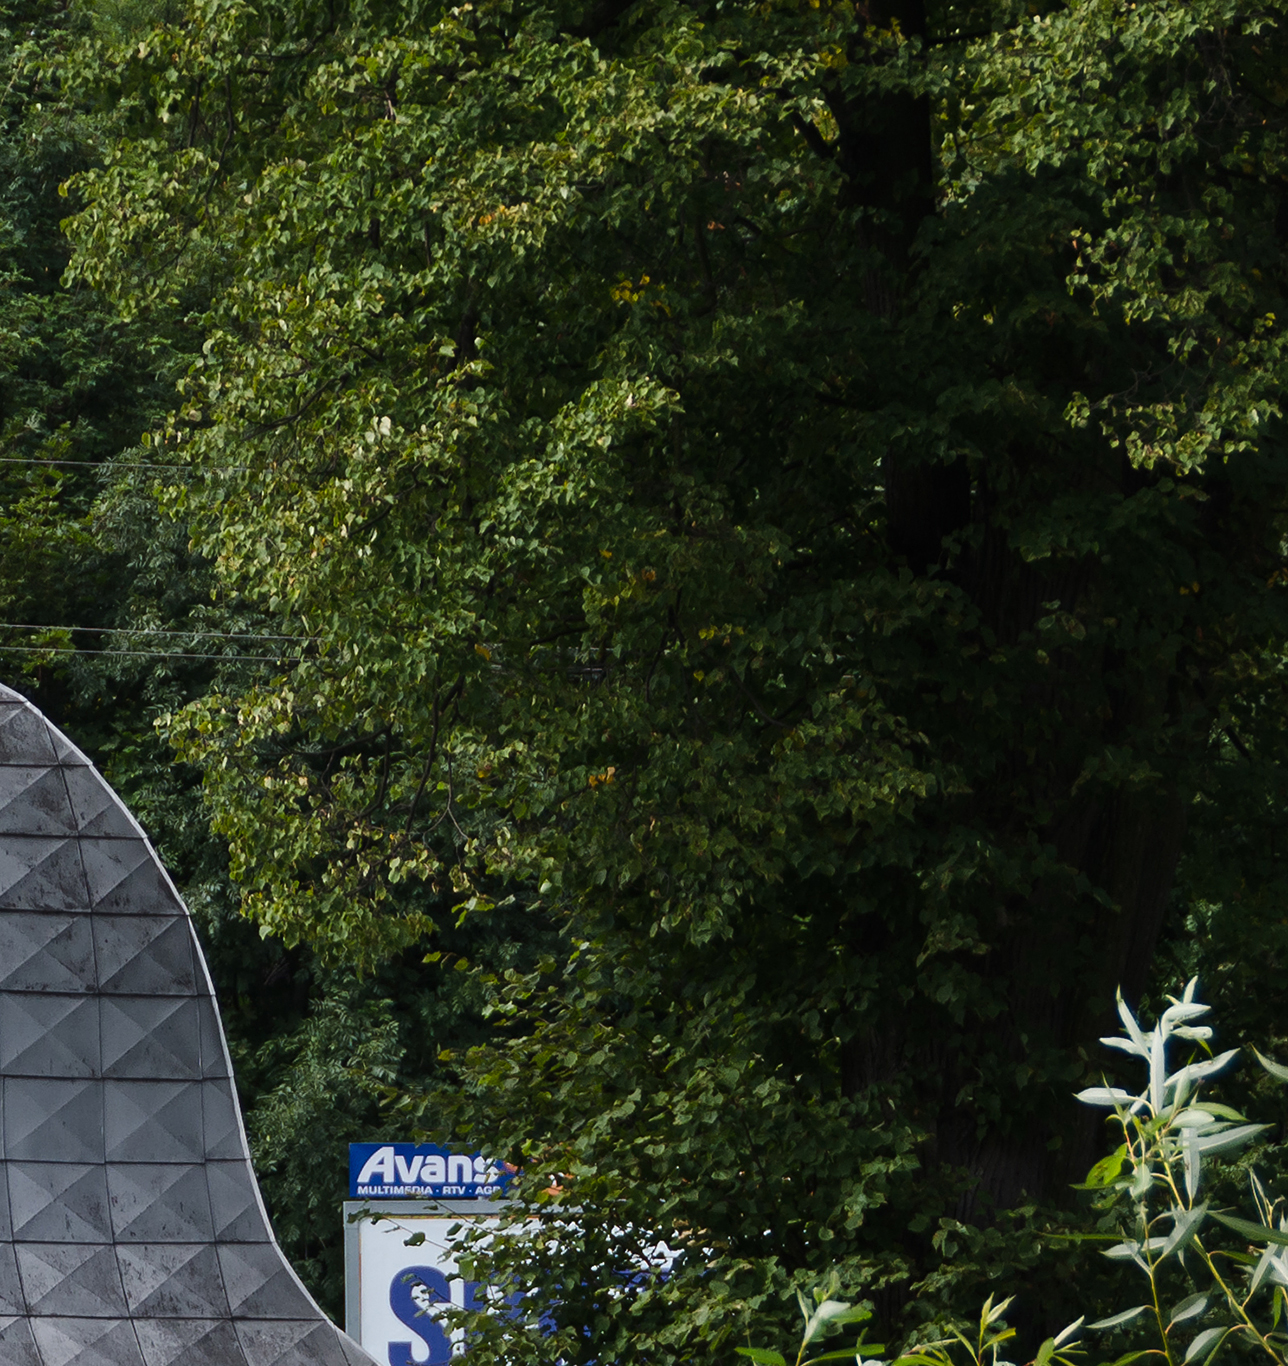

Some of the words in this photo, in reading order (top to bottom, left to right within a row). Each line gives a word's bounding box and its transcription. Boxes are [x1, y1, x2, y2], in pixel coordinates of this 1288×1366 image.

[357, 1146, 499, 1184] Avans
[357, 1185, 433, 1195] MULTIMEDIA
[442, 1185, 466, 1195] RTV
